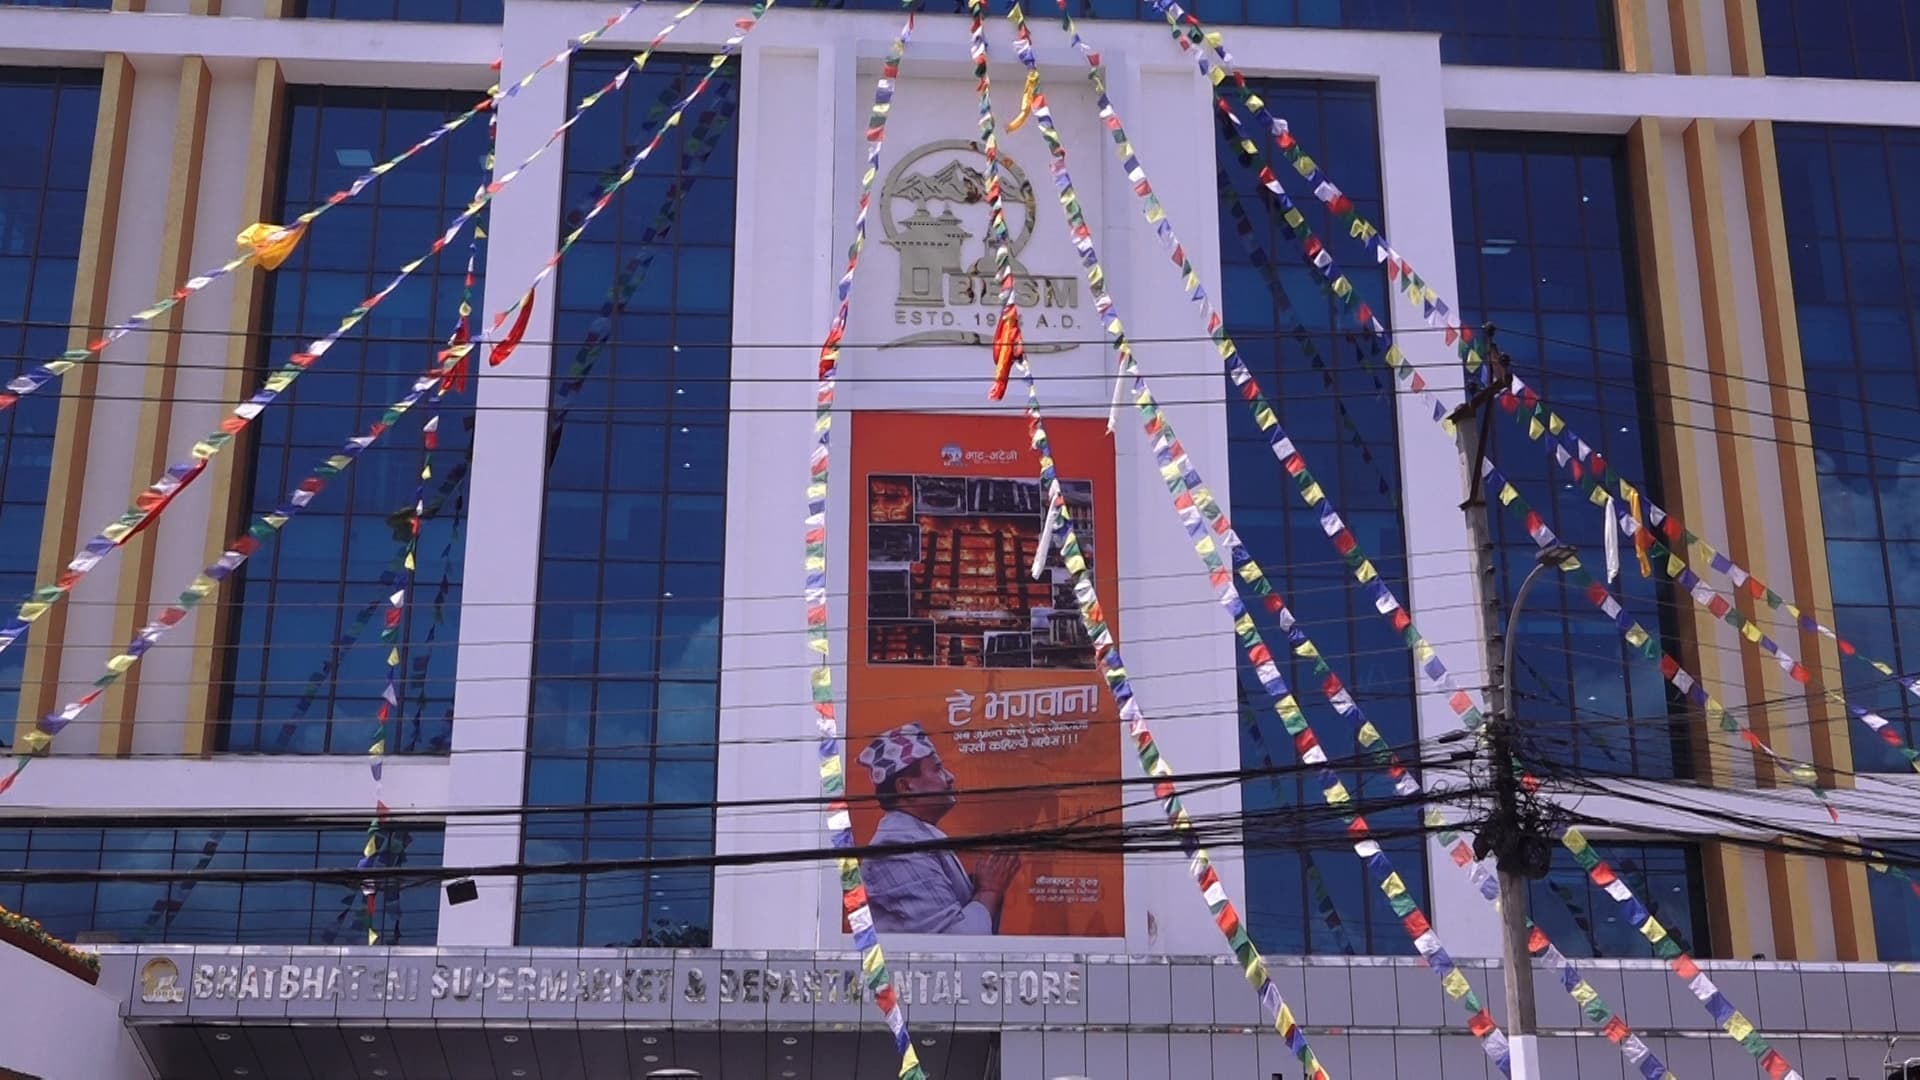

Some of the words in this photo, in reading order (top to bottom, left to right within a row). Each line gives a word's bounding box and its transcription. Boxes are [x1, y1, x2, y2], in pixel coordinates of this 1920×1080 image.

[894, 311, 961, 327] ESTD.
[975, 313, 1024, 328] 19
[1036, 313, 1081, 330] A.D.
[945, 689, 975, 726] हे
[985, 684, 1099, 721] भगवान!
[193, 964, 418, 1001] BHATBHATENI
[431, 965, 673, 1003] SUPERMARKET
[684, 968, 707, 1003] &
[720, 968, 970, 1005] DEPARTMNTAL
[980, 969, 1081, 1006] STORE
